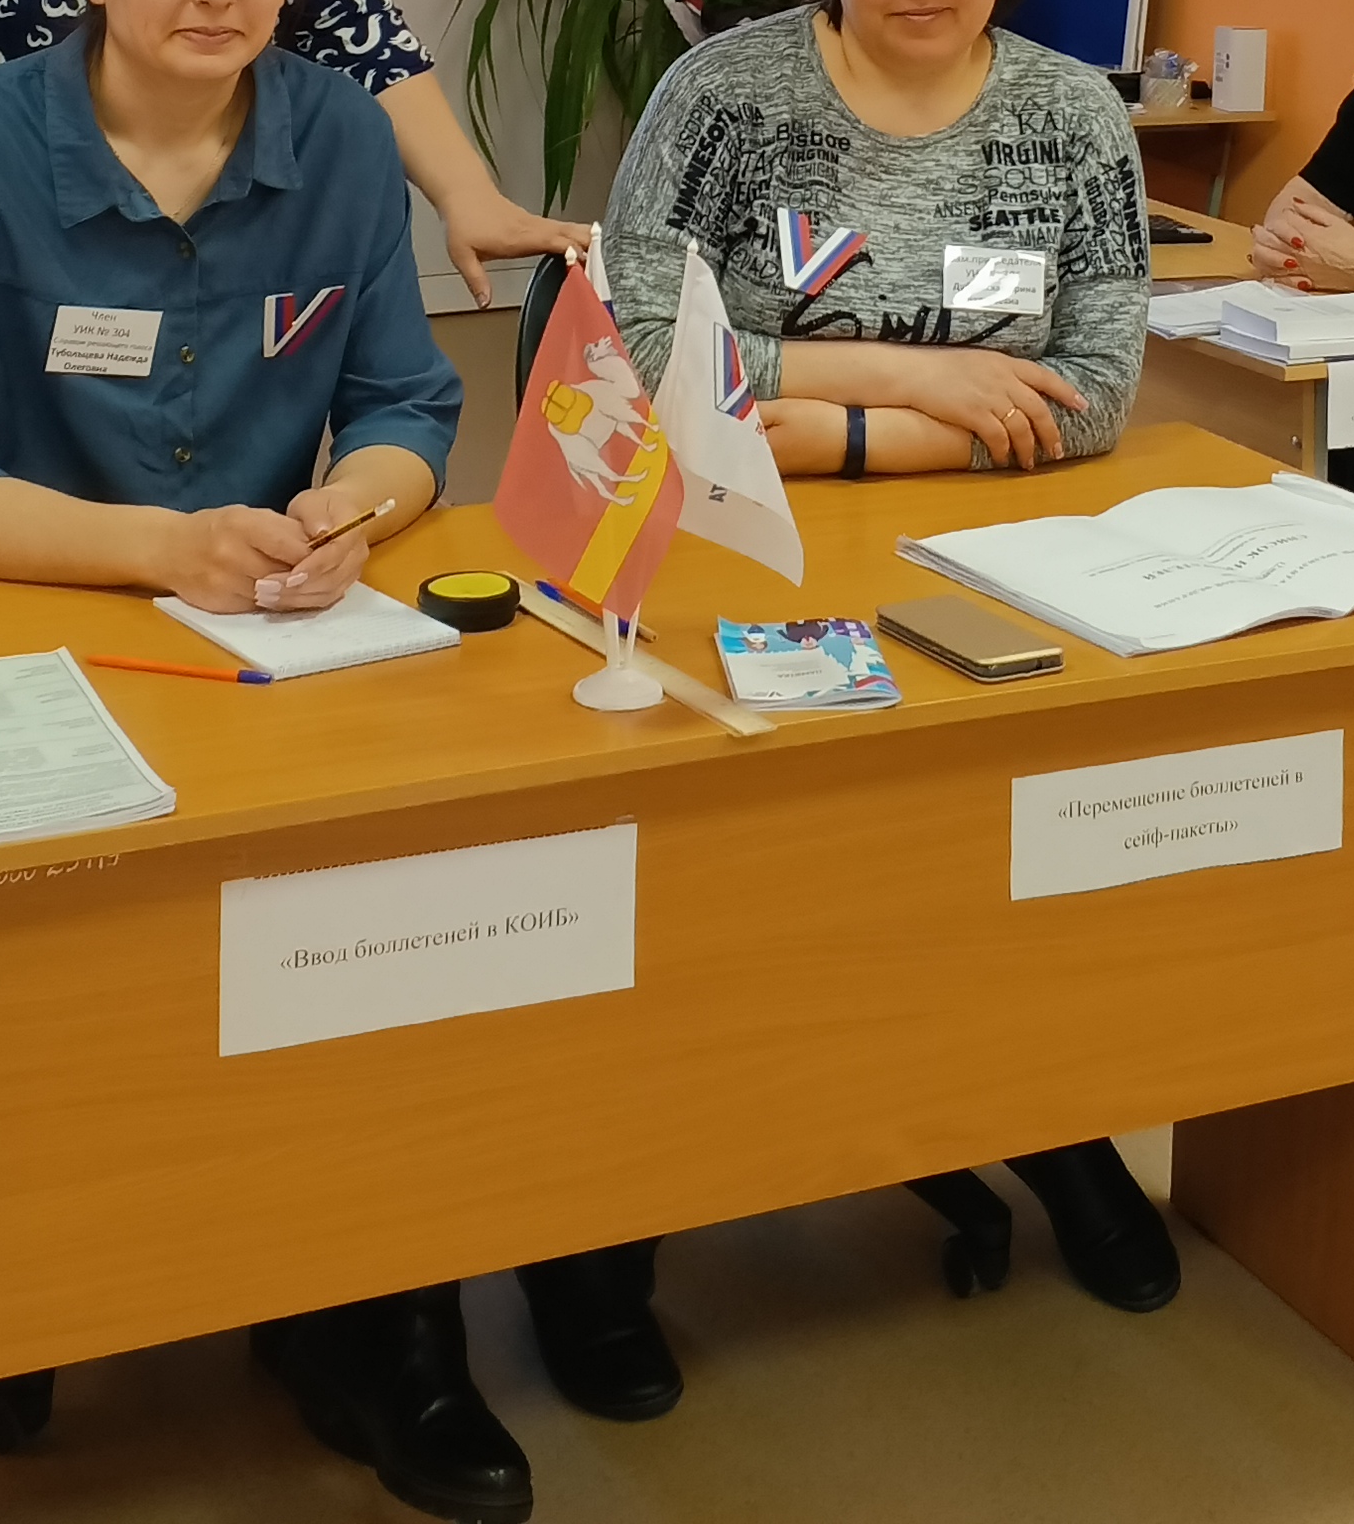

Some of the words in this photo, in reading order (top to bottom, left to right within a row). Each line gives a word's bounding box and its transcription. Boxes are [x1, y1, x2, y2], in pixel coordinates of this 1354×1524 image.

[969, 208, 1062, 232] SEATTLE
[91, 310, 117, 321] Член
[106, 352, 149, 364] Надежда
[1058, 787, 1186, 821] «Перемещение
[1190, 770, 1290, 799] бюллетеней
[1294, 770, 1304, 785] в
[1123, 818, 1239, 851] сейф-пакеты»
[280, 947, 348, 970] «Ввод
[354, 920, 480, 959] бюллетеней
[486, 923, 498, 939] в
[504, 907, 580, 936] КОИБ»
